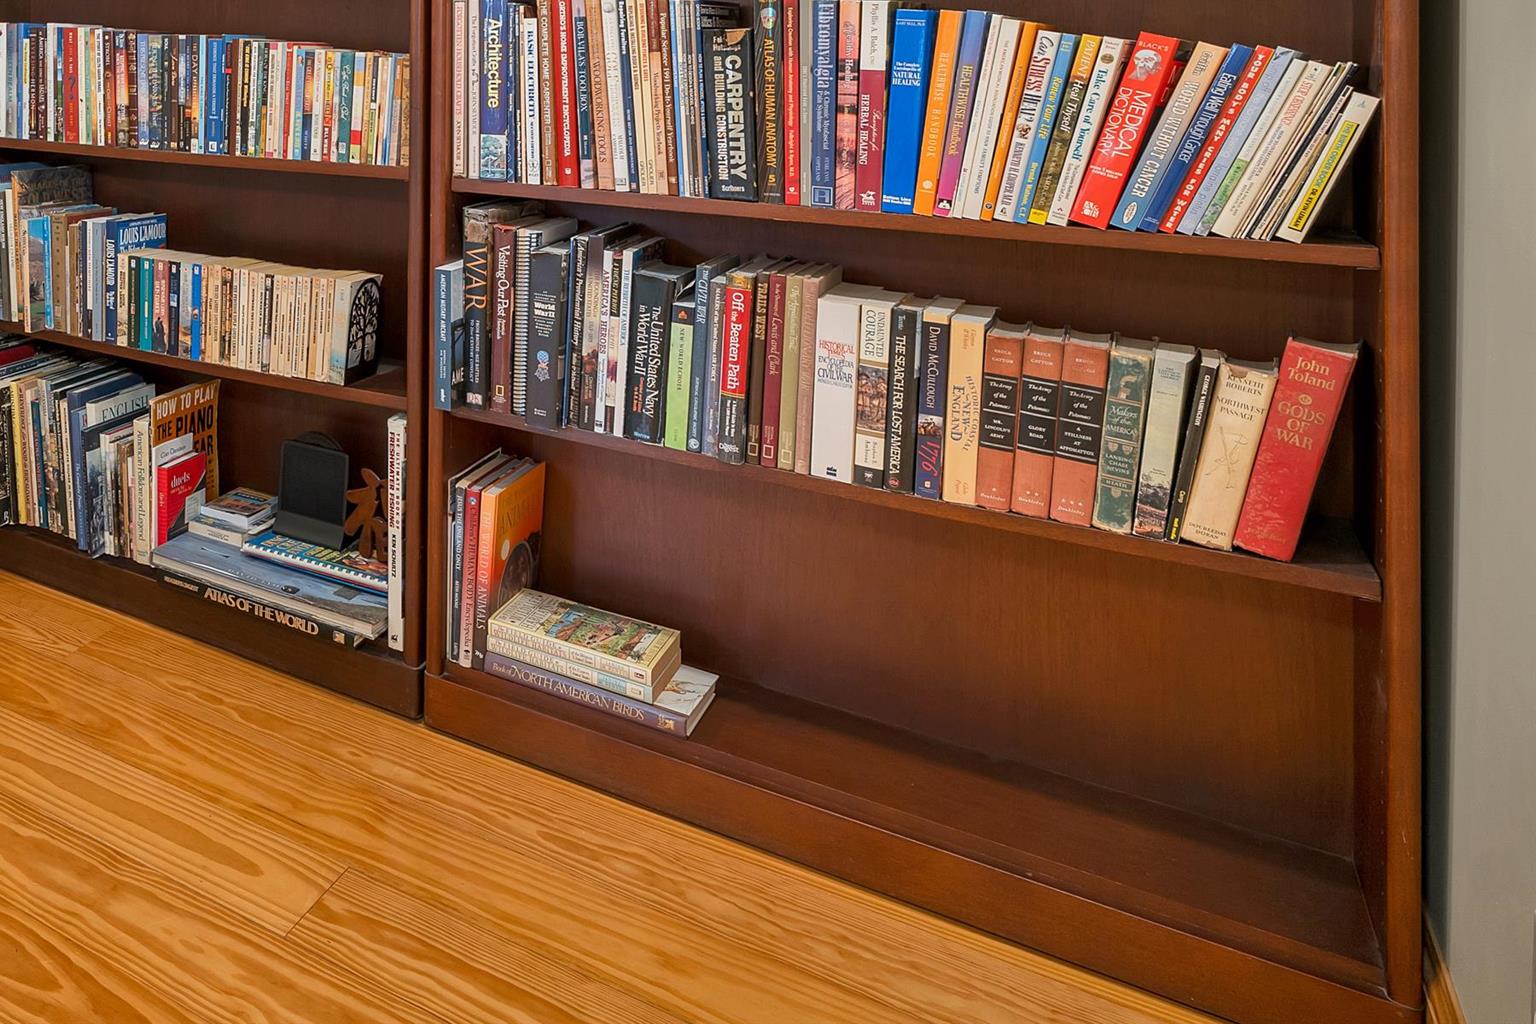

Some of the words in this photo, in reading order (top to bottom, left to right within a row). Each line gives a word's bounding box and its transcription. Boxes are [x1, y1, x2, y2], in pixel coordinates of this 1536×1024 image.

[540, 2, 548, 16] THE
[541, 18, 549, 56] COMPLETE
[763, 39, 774, 68] ATLAS
[814, 3, 833, 88] Fibromyalgia
[487, 19, 502, 108] Architecture
[542, 58, 550, 80] HOME
[713, 56, 723, 72] and
[765, 69, 774, 82] OF
[1094, 68, 1109, 89] Take
[543, 81, 551, 124] CARPENTER
[593, 61, 604, 132] WOODWORKING
[714, 74, 725, 112] BUILDING
[765, 84, 775, 120] HUMAN
[955, 65, 973, 119] HEALTHWISE
[1070, 79, 1083, 101] Heal
[1088, 93, 1101, 114] Care
[1172, 81, 1199, 116] WORLD
[725, 55, 747, 180] CARPENTRY
[860, 94, 870, 128] HERBAL
[1059, 102, 1078, 133] Thyself
[1084, 115, 1093, 126] of
[1097, 87, 1133, 157] DICTIONARY
[1111, 90, 1151, 158] MEDICAL
[598, 135, 607, 163] TOOLS
[716, 115, 729, 180] CONSTRUCTION
[766, 123, 776, 168] ANATOMY
[859, 130, 869, 165] HEALING
[948, 121, 964, 155] Handbook
[1072, 127, 1091, 162] Yourself
[1150, 117, 1182, 160] WITHOUT
[1131, 160, 1160, 198] CANCER
[106, 240, 115, 258] LOUIS
[120, 226, 139, 245] LOUIS
[140, 223, 166, 241] L'AMOUR
[106, 259, 116, 286] L'AMOUR
[465, 246, 488, 311] WAR
[496, 245, 511, 279] Visiting
[497, 279, 510, 298] Our
[601, 270, 609, 316] AMERICA'S
[732, 292, 745, 312] Off
[757, 283, 767, 314] TRAILS
[497, 298, 509, 317] Past
[651, 306, 662, 320] The
[599, 320, 608, 354] HEROES
[636, 313, 649, 348] World
[649, 321, 663, 356] United
[729, 322, 742, 362] Beaten
[755, 316, 766, 340] WEST
[864, 310, 875, 356] COURAGE
[875, 312, 885, 357] UNDAUNTED
[896, 336, 906, 353] THE
[635, 349, 647, 367] War
[635, 367, 646, 375] II
[647, 357, 661, 388] States
[894, 355, 905, 390] SEARCH
[1296, 356, 1330, 376] John
[727, 364, 740, 389] Path
[1288, 367, 1336, 391] Toland
[157, 398, 177, 419] HOW
[181, 393, 192, 410] TO
[194, 383, 216, 405] PLAY
[643, 390, 659, 417] Navy
[893, 392, 903, 409] FOR
[1278, 401, 1326, 425] GODS
[157, 420, 172, 441] THE
[176, 404, 213, 438] PIANO
[891, 411, 901, 434] LOST
[1287, 419, 1311, 432] OF
[136, 431, 145, 466] American
[889, 436, 900, 474] AMERICA
[1276, 429, 1313, 451] WAR
[918, 441, 941, 475] 1776
[137, 467, 145, 494] Folklore
[137, 495, 146, 512] and
[137, 513, 146, 542] Legend
[204, 587, 236, 608] ATLAS
[237, 598, 254, 612] OF
[253, 604, 276, 621] THE
[274, 611, 319, 635] WORLD
[512, 666, 553, 690] NORTH
[554, 681, 610, 709] AMERICAN
[613, 700, 645, 721] BIRDS
